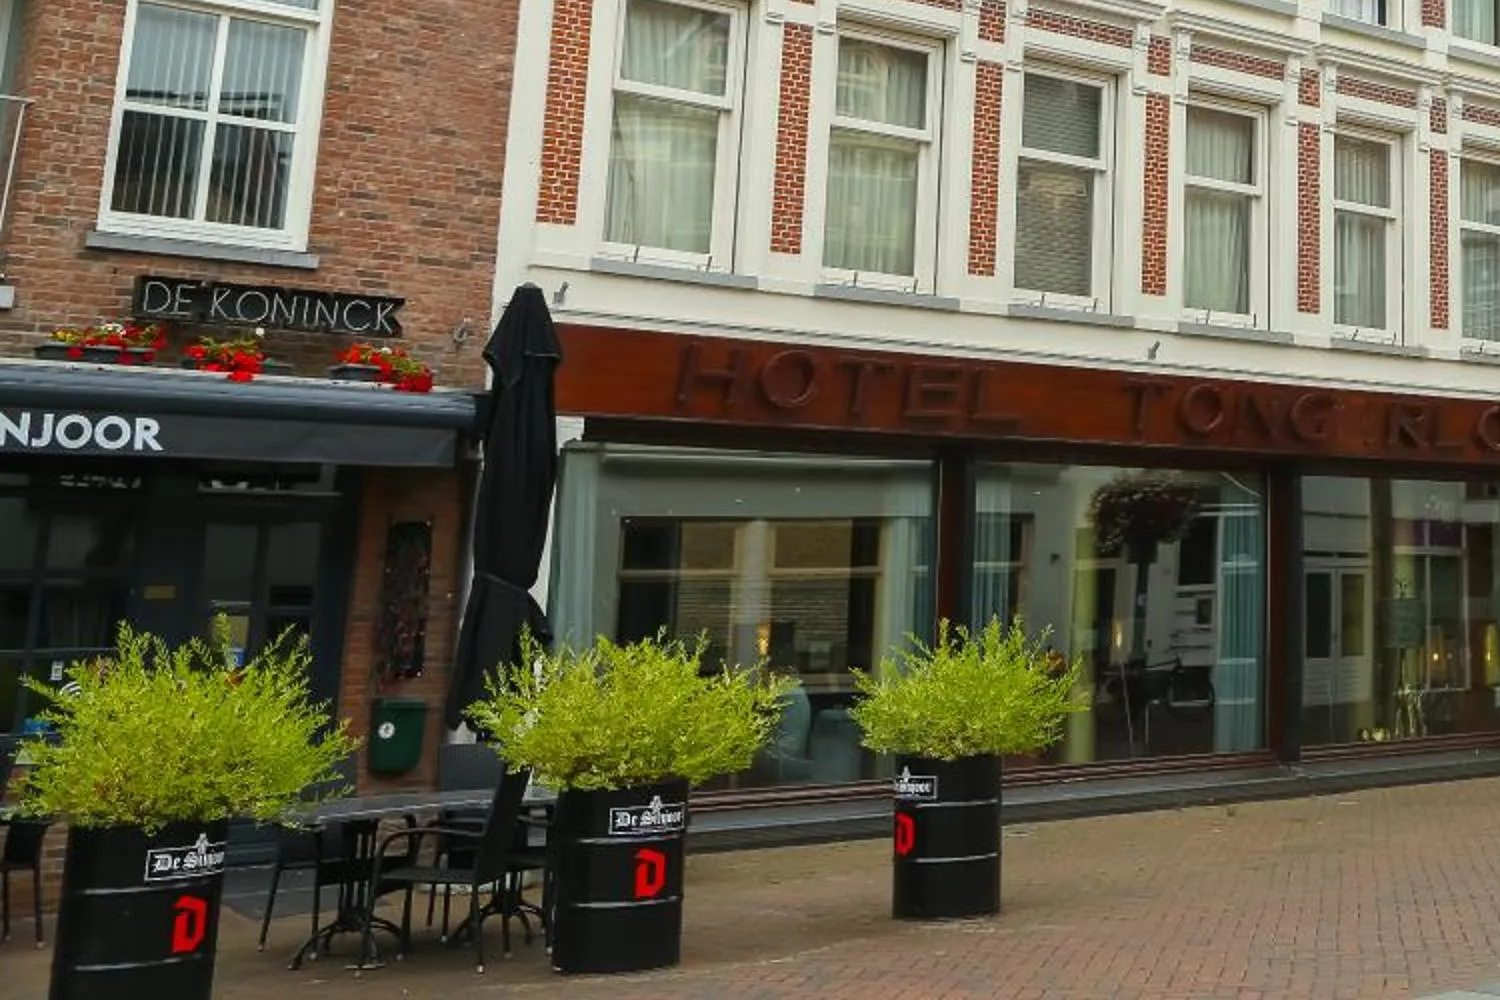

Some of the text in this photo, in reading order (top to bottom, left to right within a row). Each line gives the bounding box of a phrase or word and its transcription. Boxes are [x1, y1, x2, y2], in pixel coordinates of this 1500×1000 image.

[143, 281, 396, 333] DE KONINCK
[678, 341, 1019, 425] HOTEL
[150, 853, 181, 873] De
[633, 846, 665, 898] D
[171, 894, 208, 953] D
